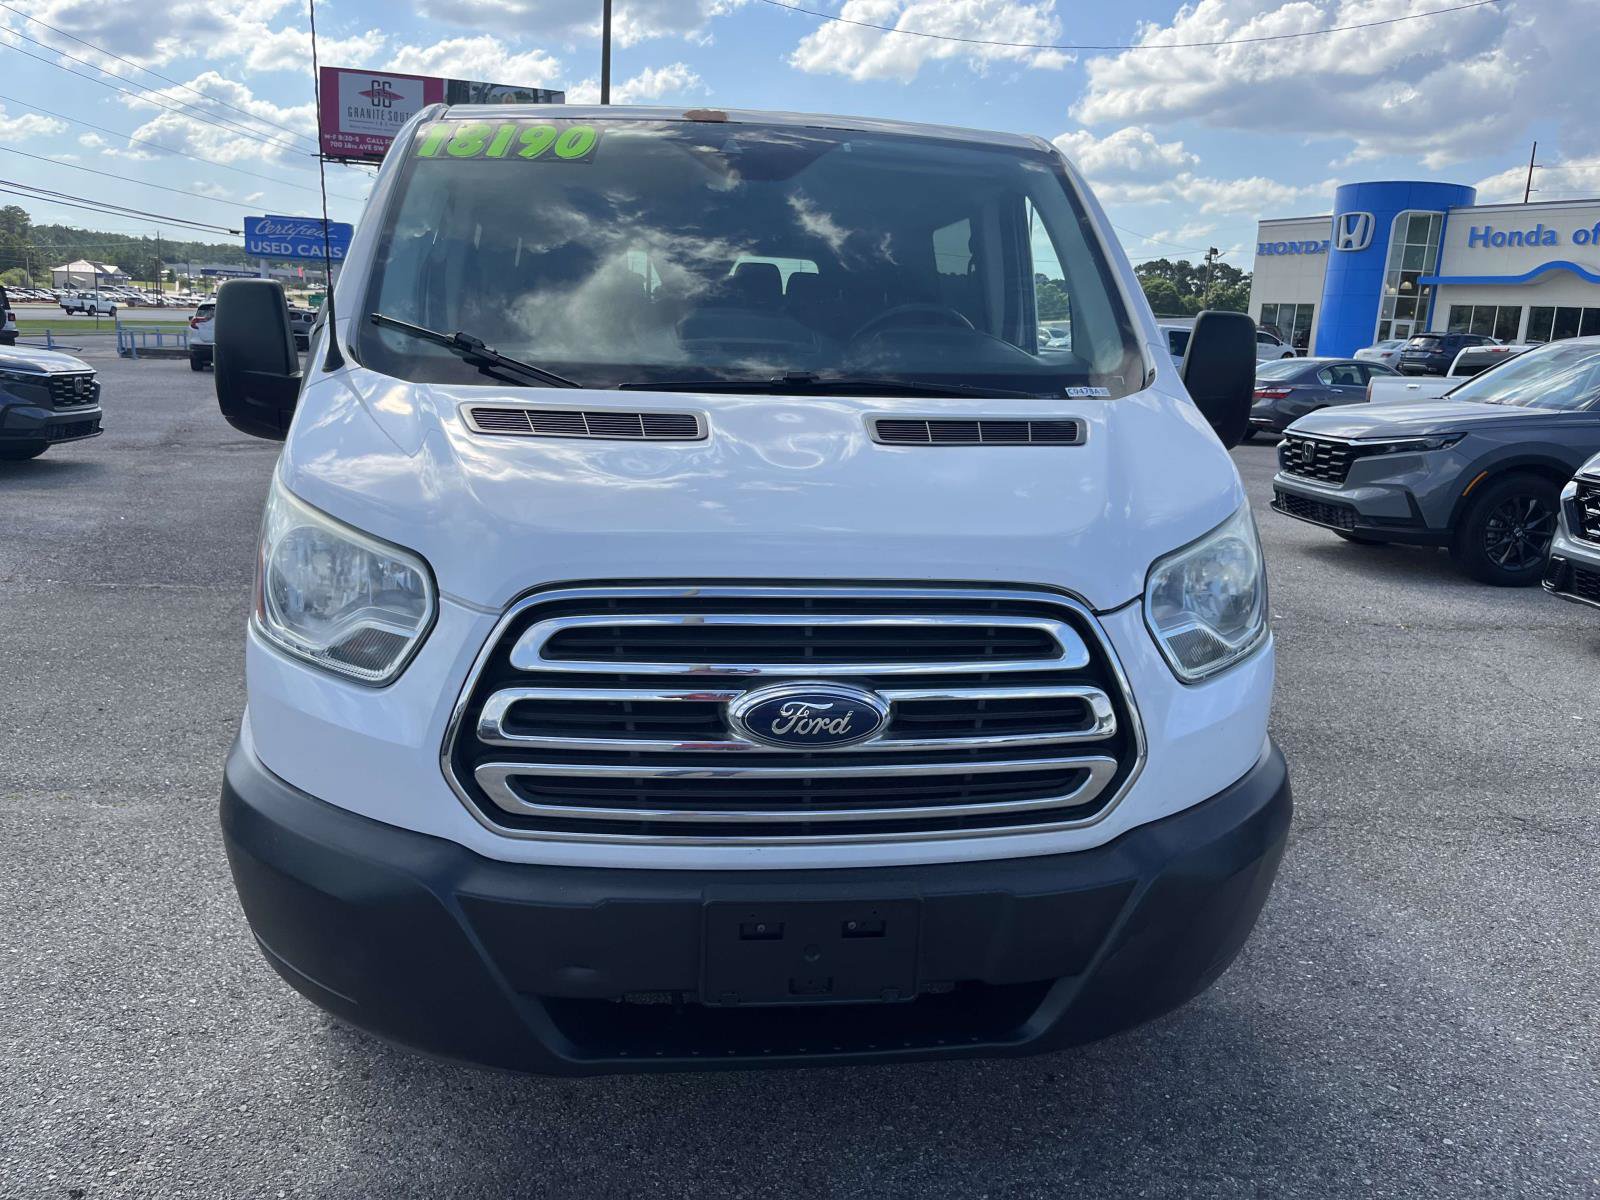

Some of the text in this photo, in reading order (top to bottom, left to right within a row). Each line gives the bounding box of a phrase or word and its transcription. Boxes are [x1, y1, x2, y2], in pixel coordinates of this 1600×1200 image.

[347, 106, 385, 121] GRANITE
[359, 143, 373, 151] AVE
[366, 137, 384, 145] CALL
[417, 123, 597, 159] 18190
[255, 219, 336, 240] Certified
[1468, 222, 1600, 248] Honda of
[250, 241, 293, 255] USED
[771, 701, 854, 735] Ford
